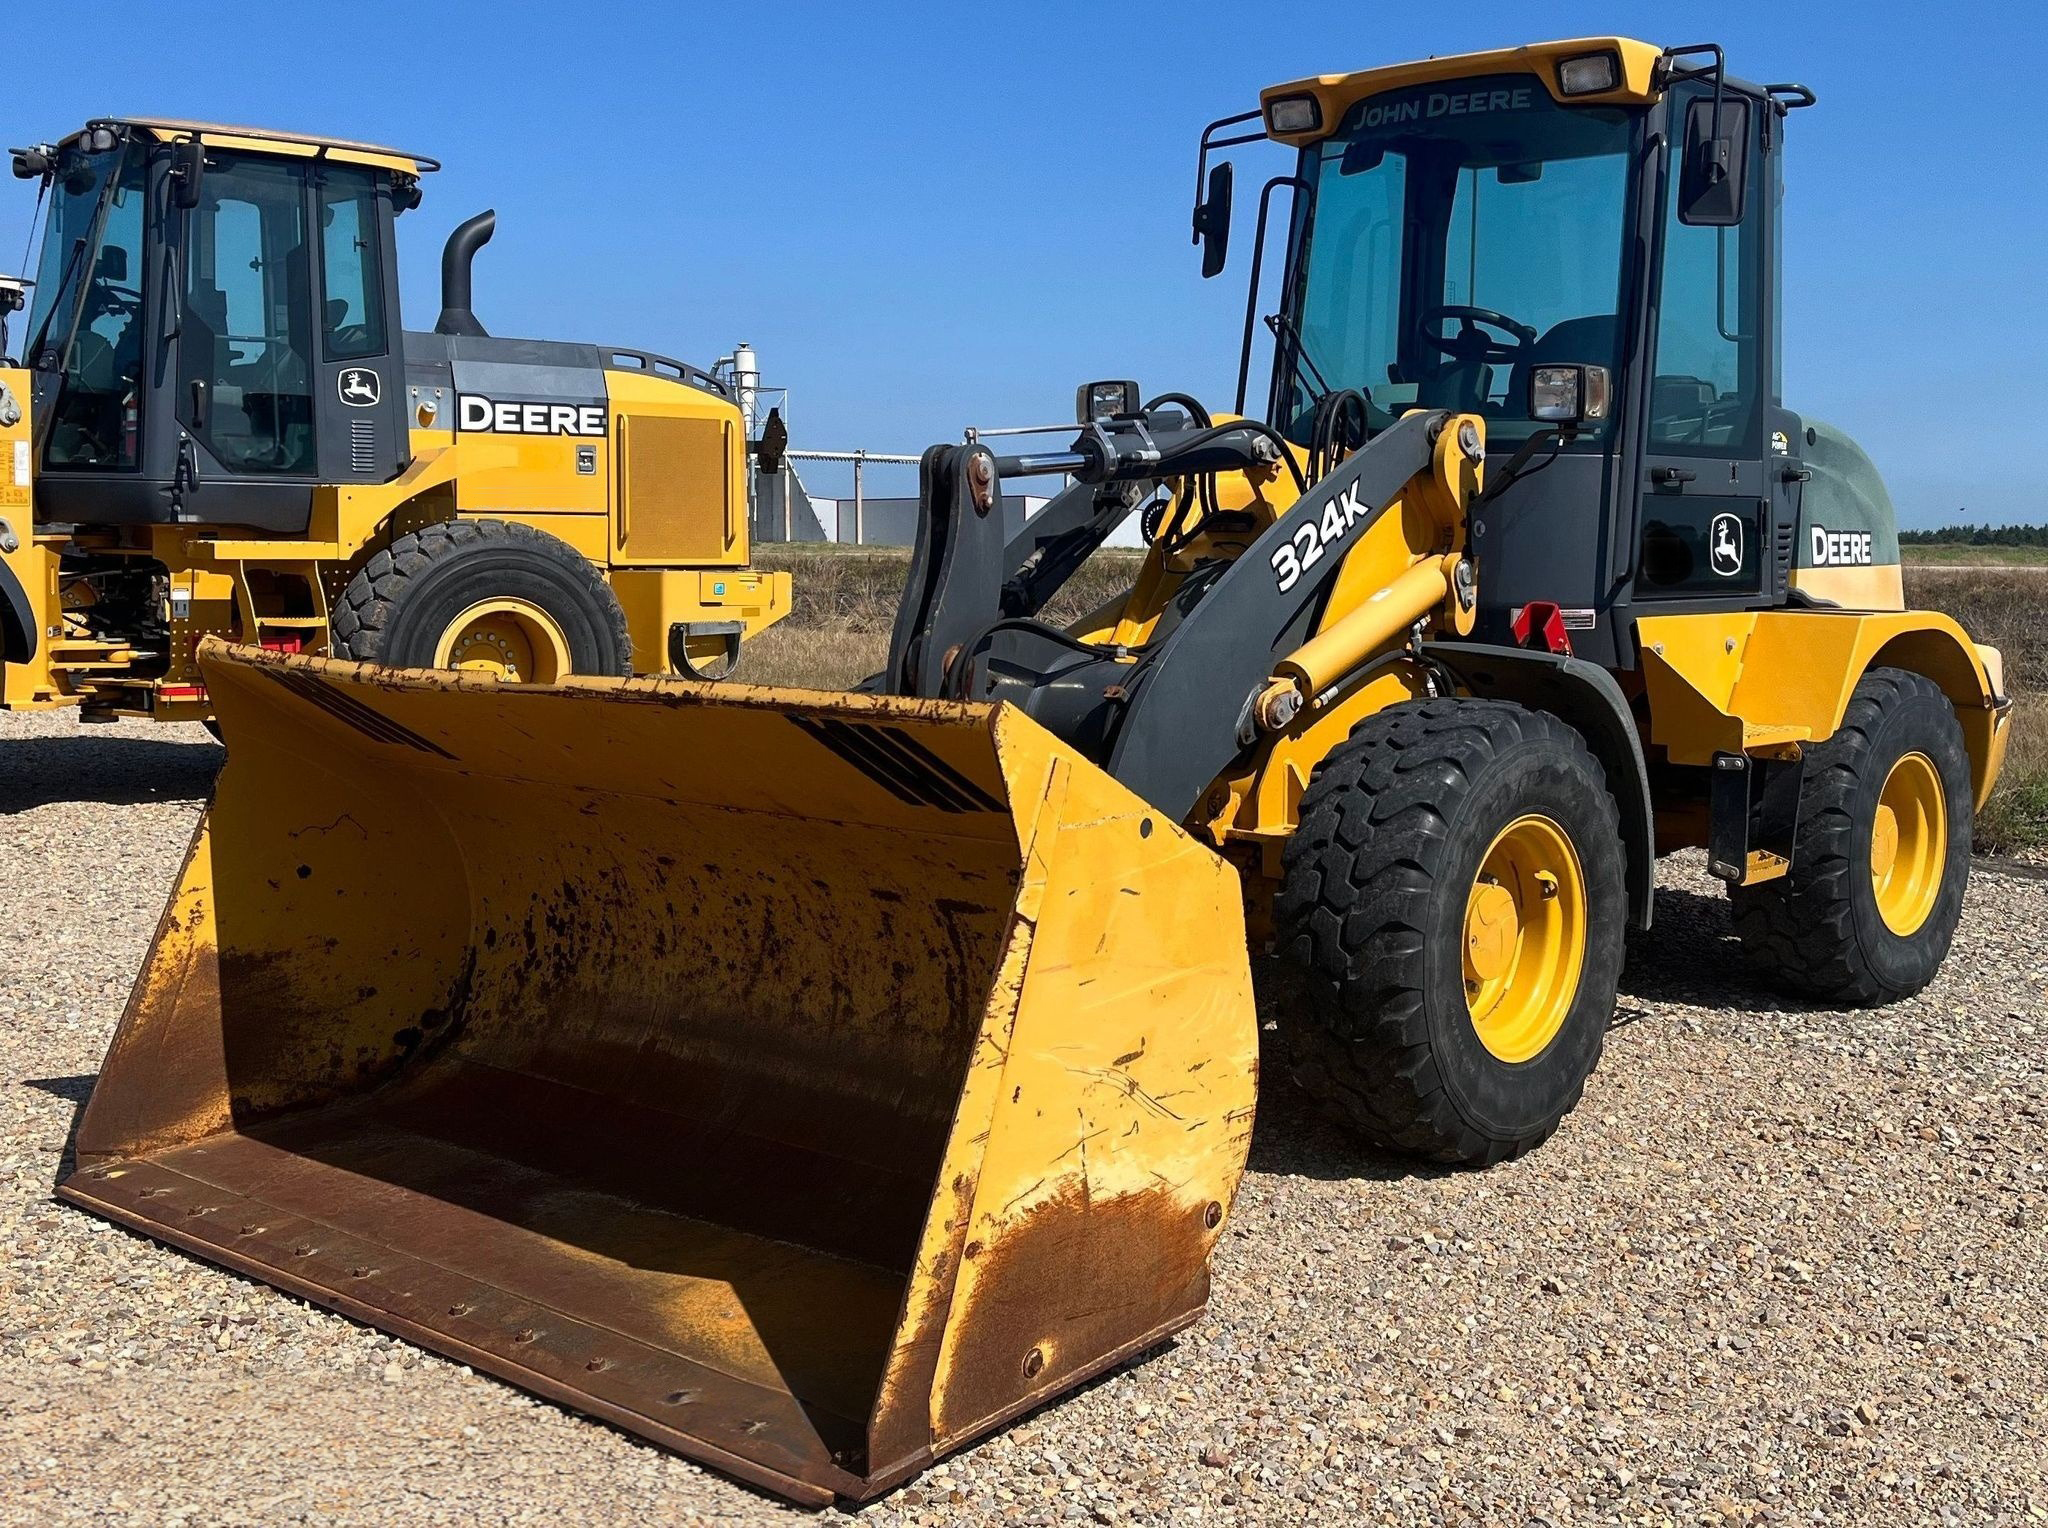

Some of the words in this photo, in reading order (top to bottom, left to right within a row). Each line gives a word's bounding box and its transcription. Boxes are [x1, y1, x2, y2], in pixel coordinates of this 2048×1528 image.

[1353, 100, 1420, 131] JOHN
[1426, 88, 1532, 118] DEERE
[459, 395, 605, 435] DEERE
[1271, 478, 1370, 593] 324K
[1811, 526, 1871, 565] DEERE
